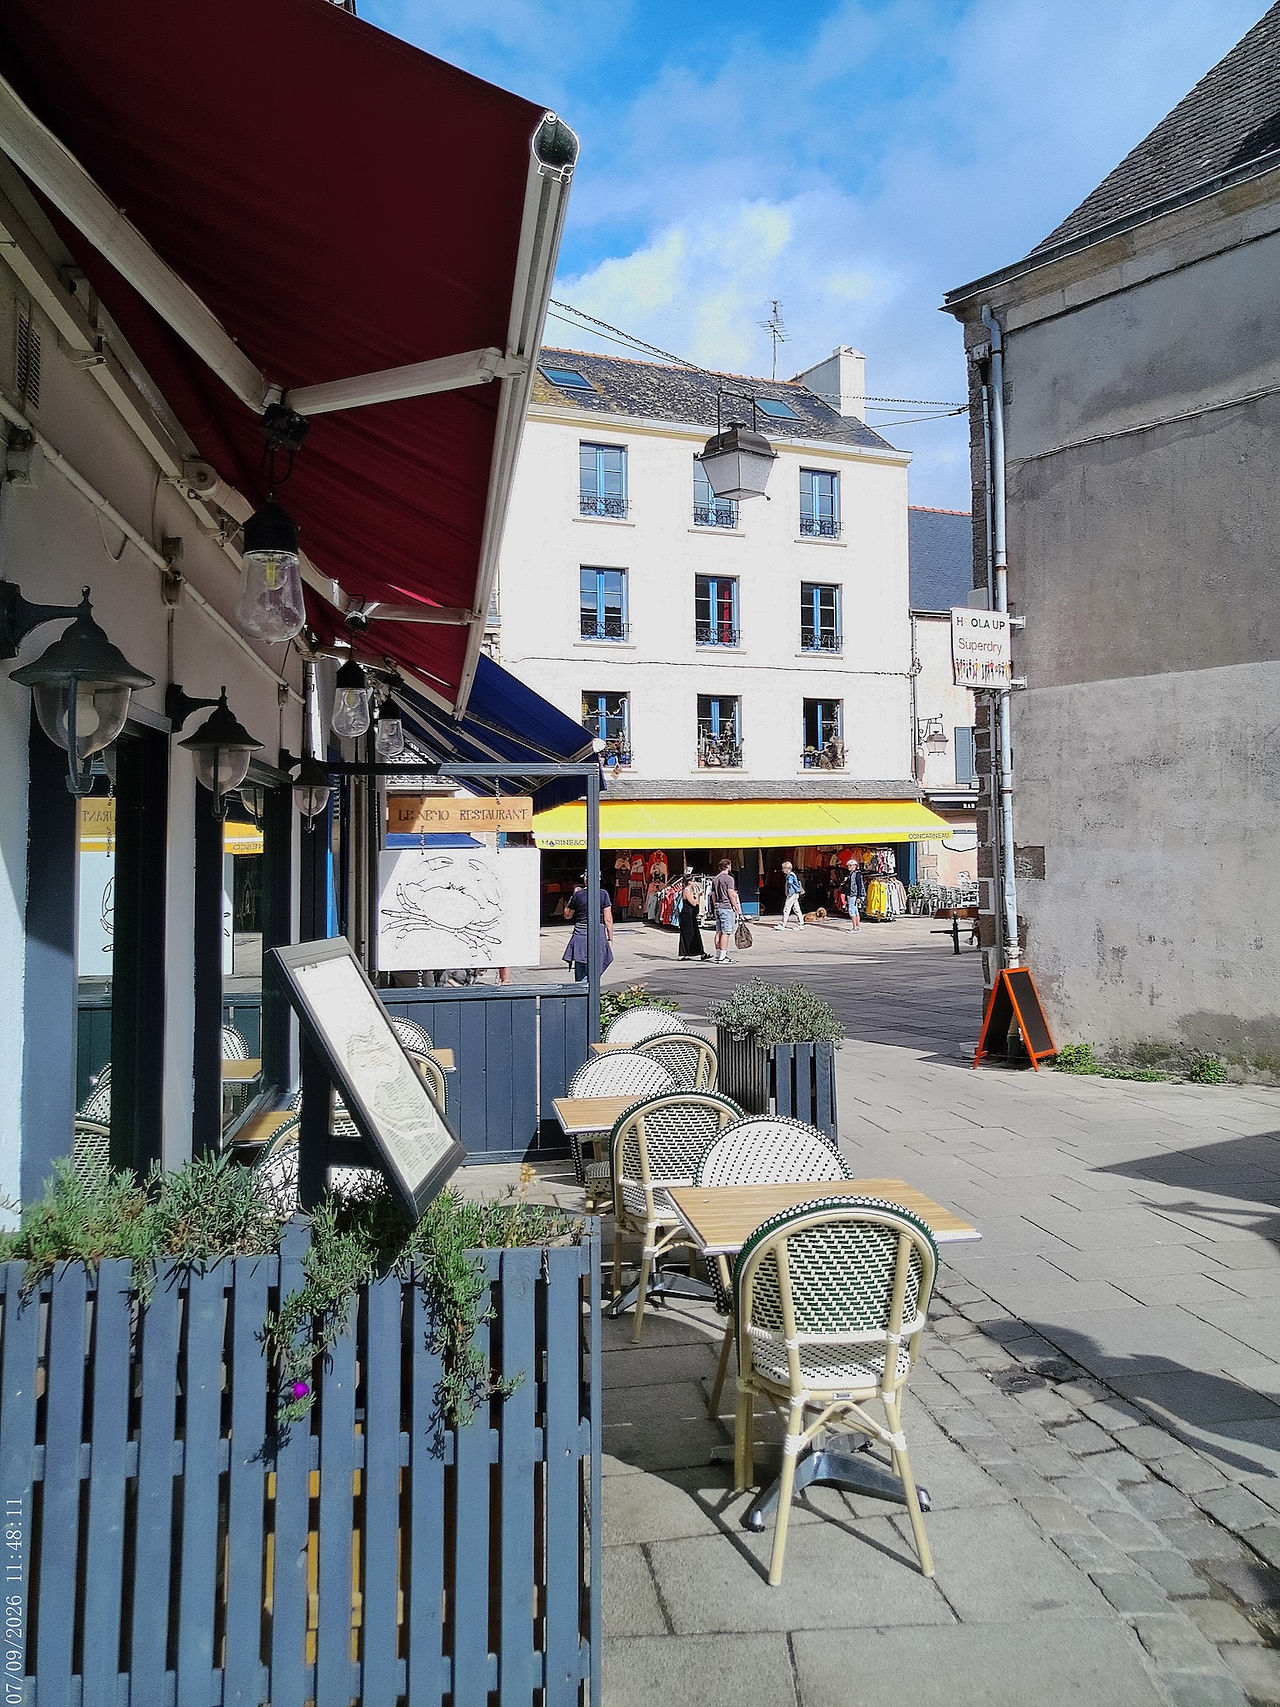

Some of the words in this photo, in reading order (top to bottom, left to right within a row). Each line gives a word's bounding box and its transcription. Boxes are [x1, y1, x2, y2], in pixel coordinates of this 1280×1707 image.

[993, 620, 1005, 630] UP
[959, 638, 1002, 655] Superdry
[398, 810, 414, 821] LE
[459, 808, 528, 821] RESTAURANT
[908, 832, 949, 841] CONCARNEAU
[541, 839, 587, 847] MARINE&C
